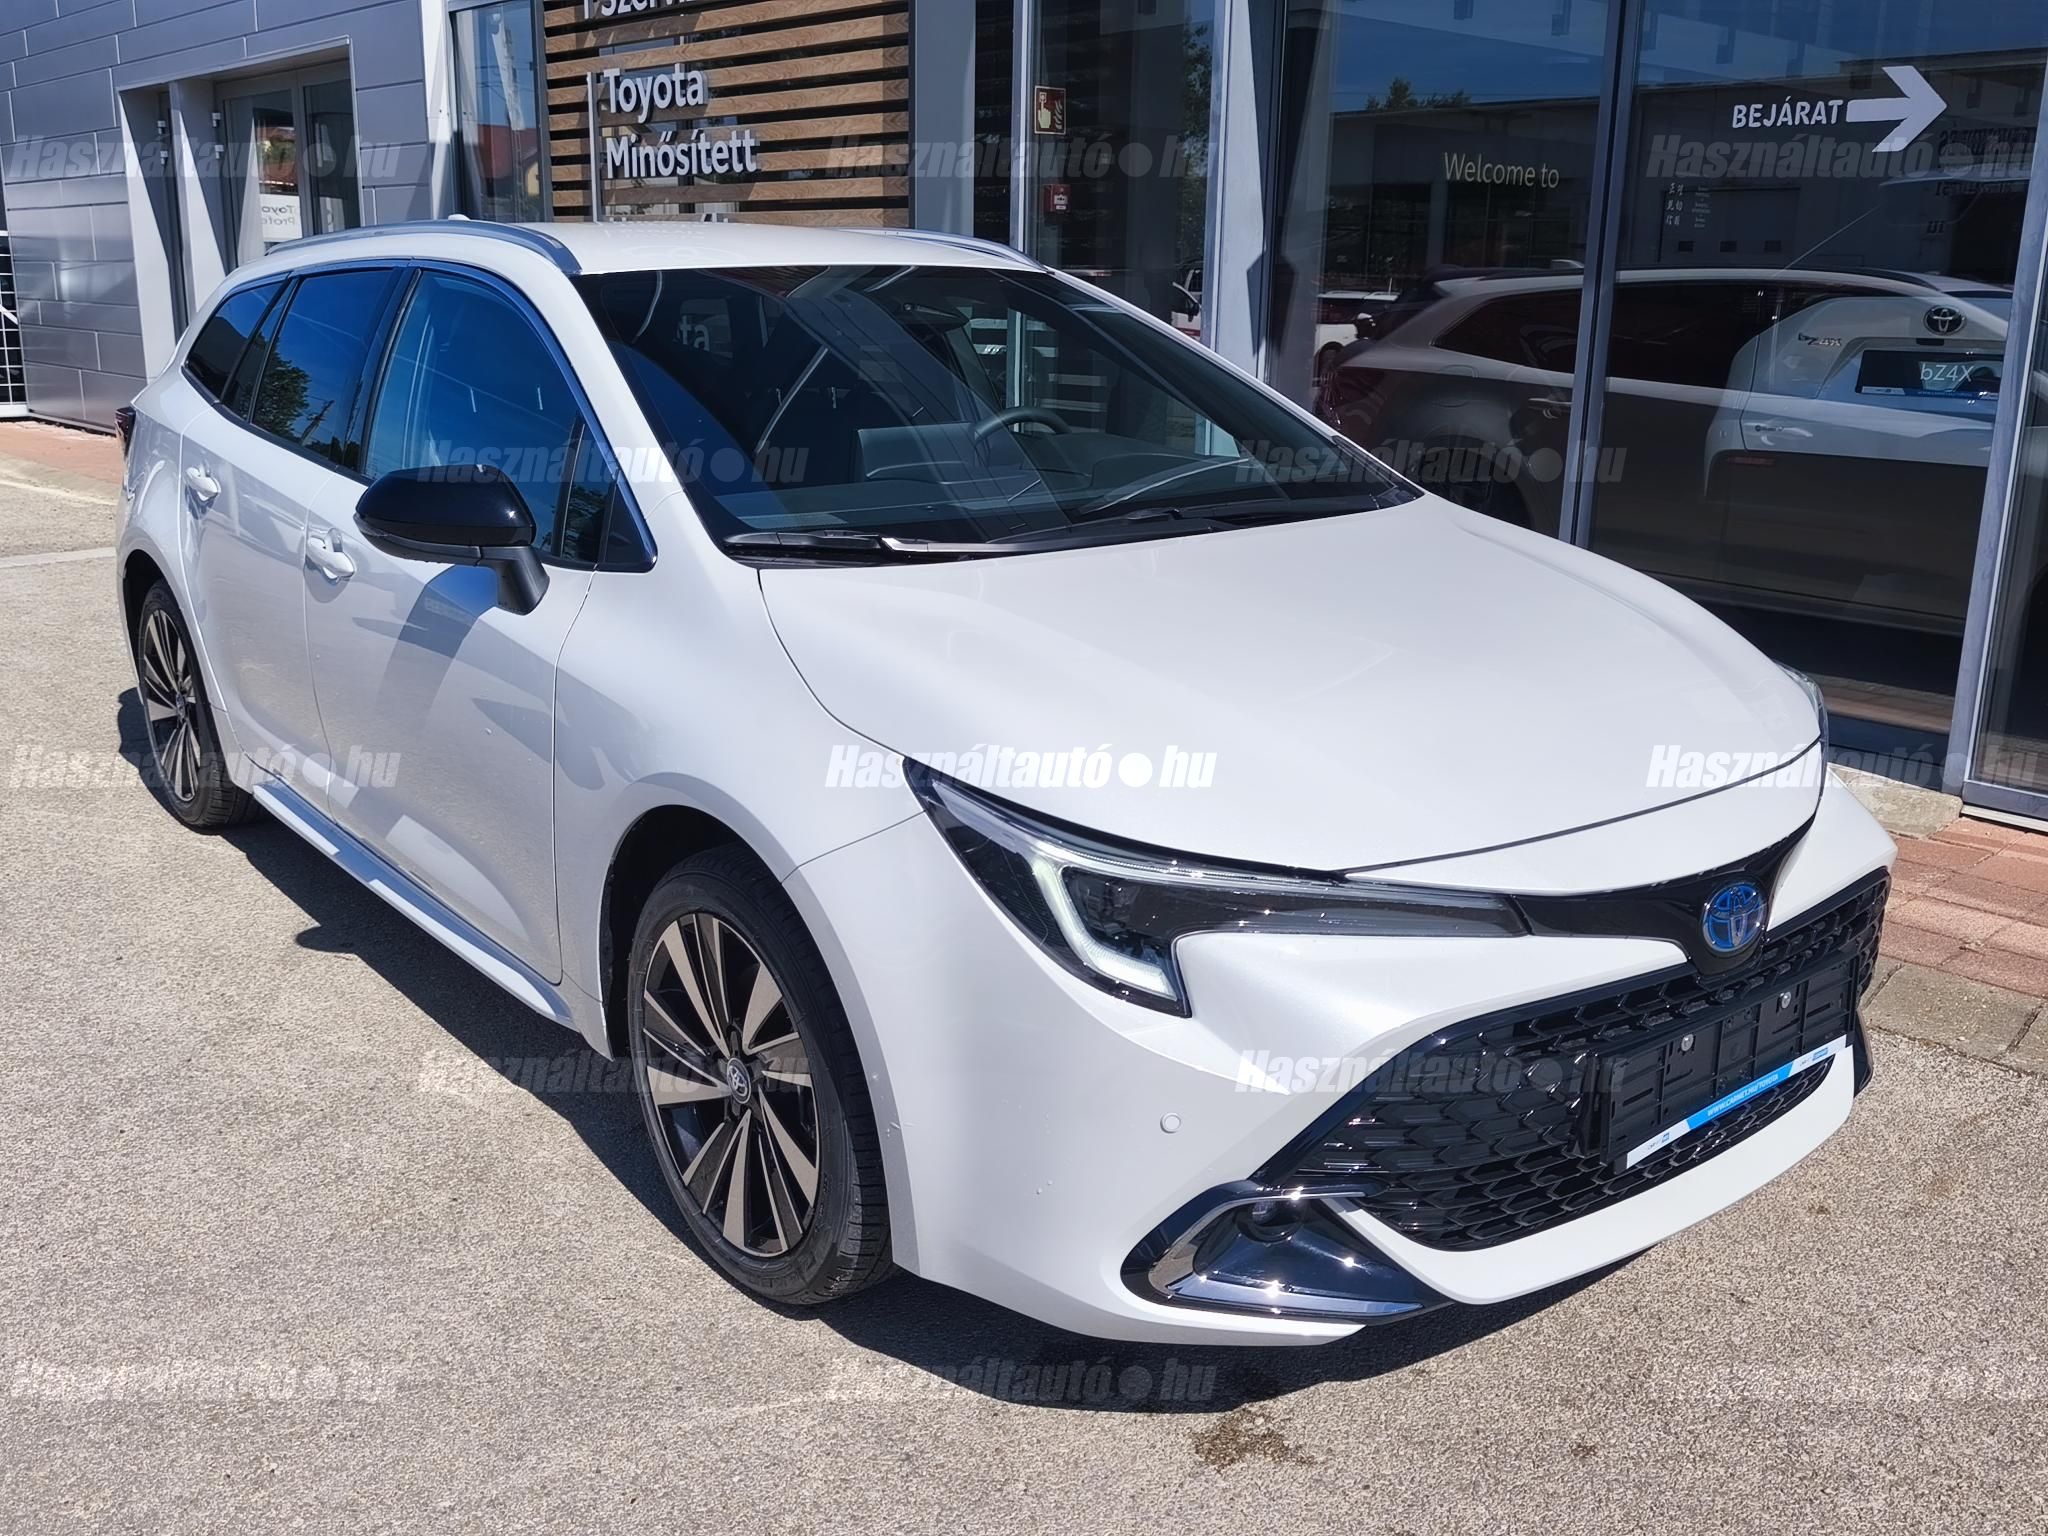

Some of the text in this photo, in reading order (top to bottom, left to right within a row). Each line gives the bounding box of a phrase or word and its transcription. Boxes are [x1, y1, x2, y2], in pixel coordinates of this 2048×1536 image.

[604, 63, 704, 124] Toyota
[1732, 96, 1844, 128] BEJÁRAT
[605, 128, 758, 179] Minősített
[1444, 151, 1560, 188] Welcome to
[1920, 363, 1974, 382] bZ4X
